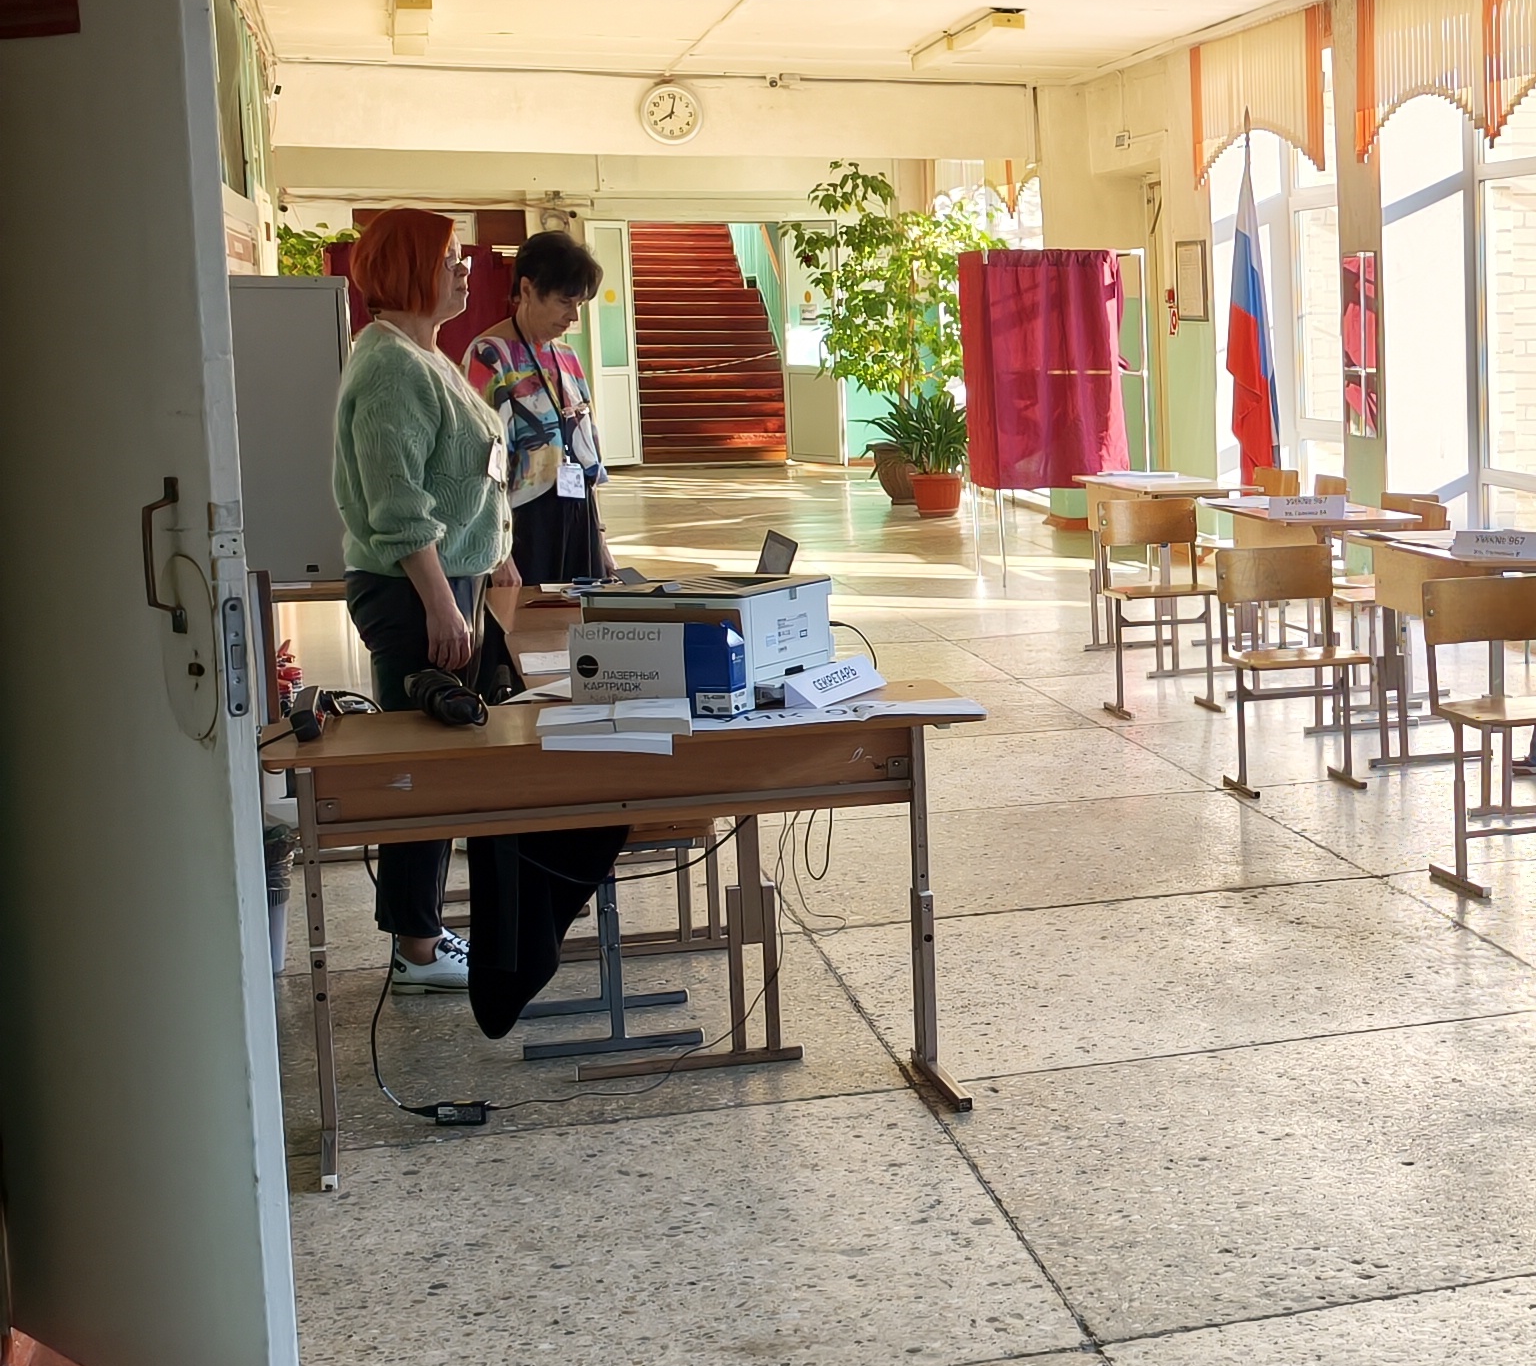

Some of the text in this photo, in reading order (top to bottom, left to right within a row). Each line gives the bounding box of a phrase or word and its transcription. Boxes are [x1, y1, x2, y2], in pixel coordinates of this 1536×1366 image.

[1508, 535, 1526, 545] 967
[574, 627, 662, 641] NetProduct
[602, 669, 660, 681] ЛАЗЕРНЫЙ
[812, 665, 858, 691] СЕКРЕТАРЬ
[583, 681, 642, 693] КАРТРИДЖ
